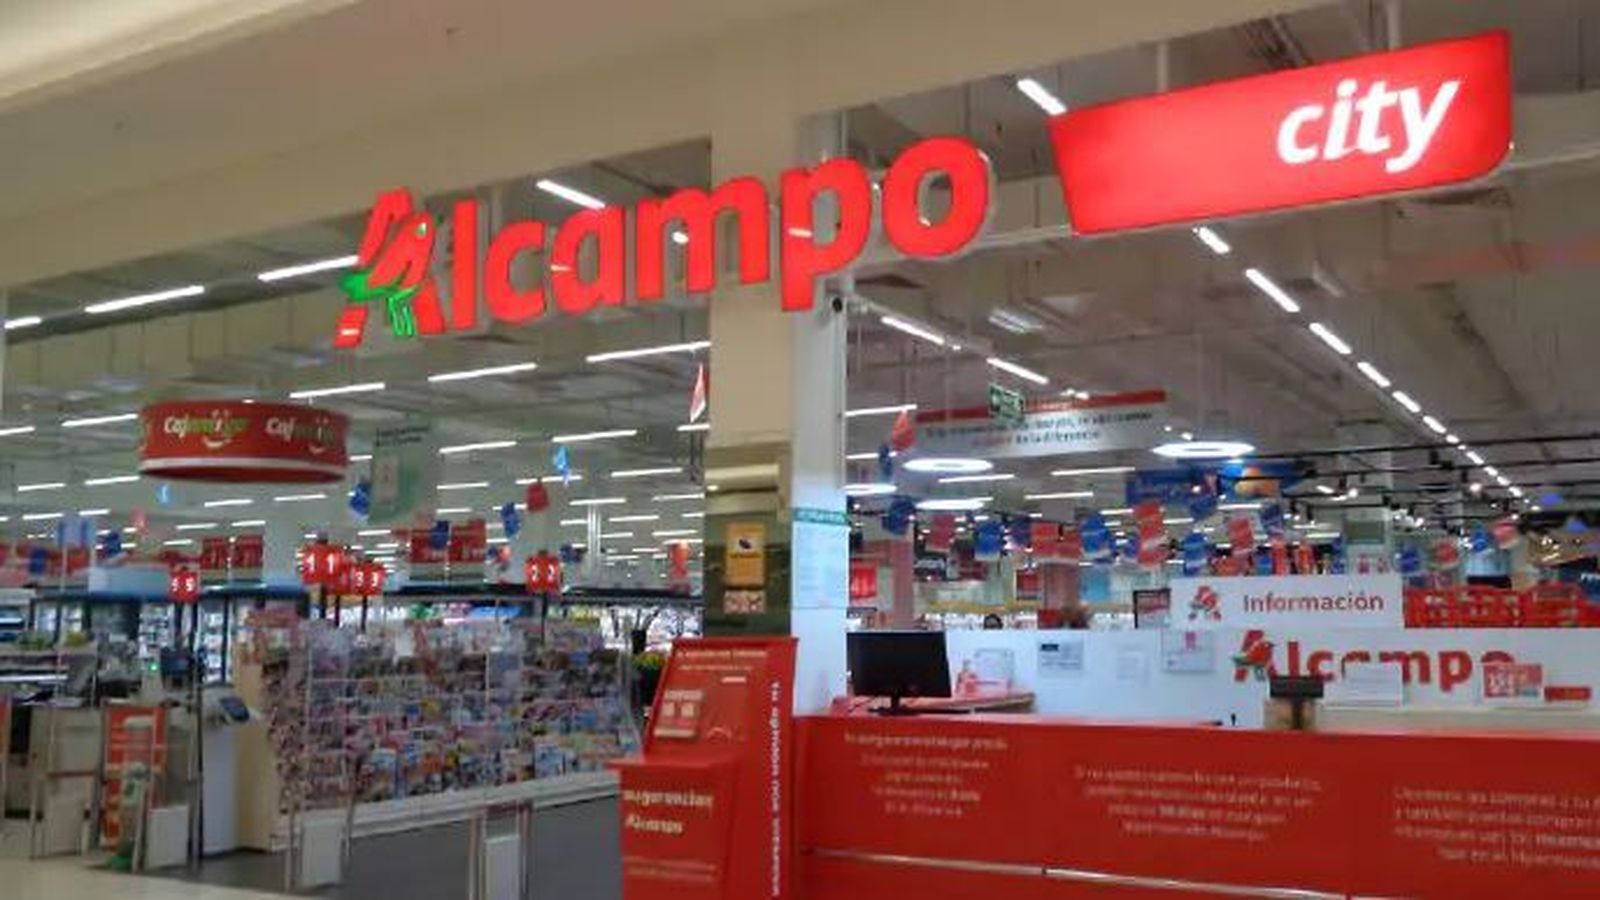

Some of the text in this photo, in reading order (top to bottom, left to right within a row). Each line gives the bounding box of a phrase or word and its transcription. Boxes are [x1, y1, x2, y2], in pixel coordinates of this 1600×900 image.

[1277, 78, 1461, 174] city
[332, 135, 990, 347] Alcampo
[1243, 590, 1385, 614] Información
